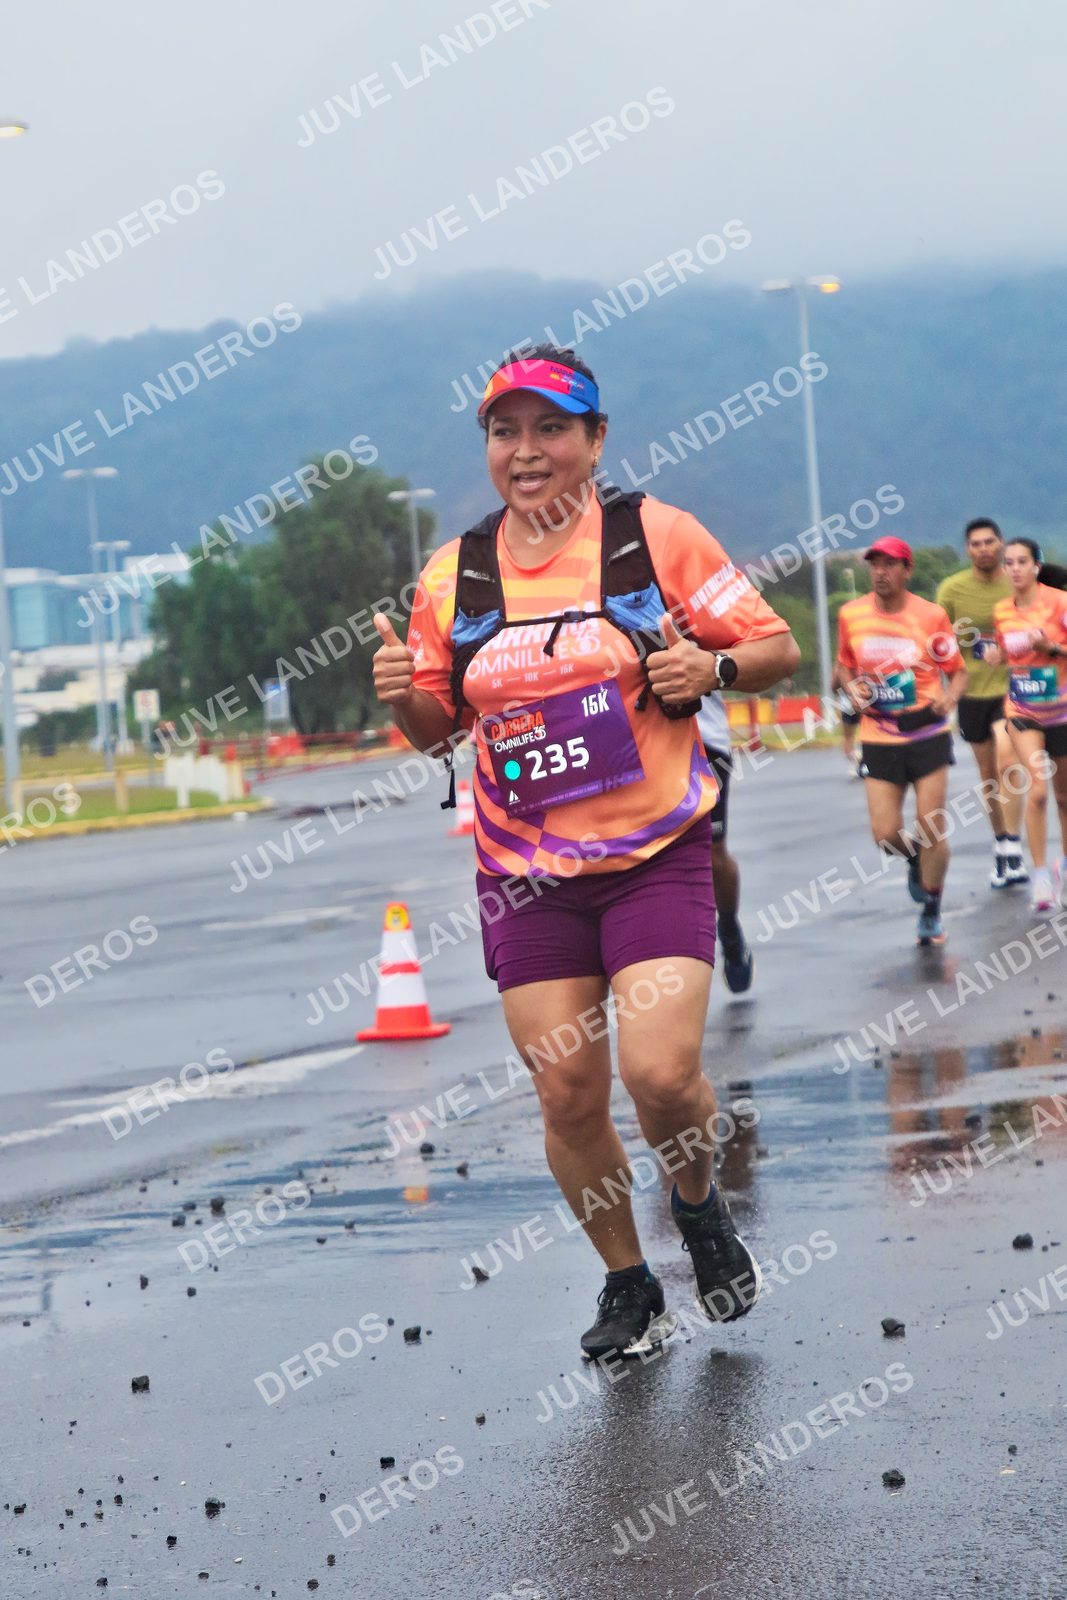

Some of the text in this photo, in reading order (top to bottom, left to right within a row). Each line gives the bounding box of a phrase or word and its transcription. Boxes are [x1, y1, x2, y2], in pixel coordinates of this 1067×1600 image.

[581, 689, 610, 717] 15K
[491, 711, 545, 740] CARRERA
[524, 736, 590, 781] 235
